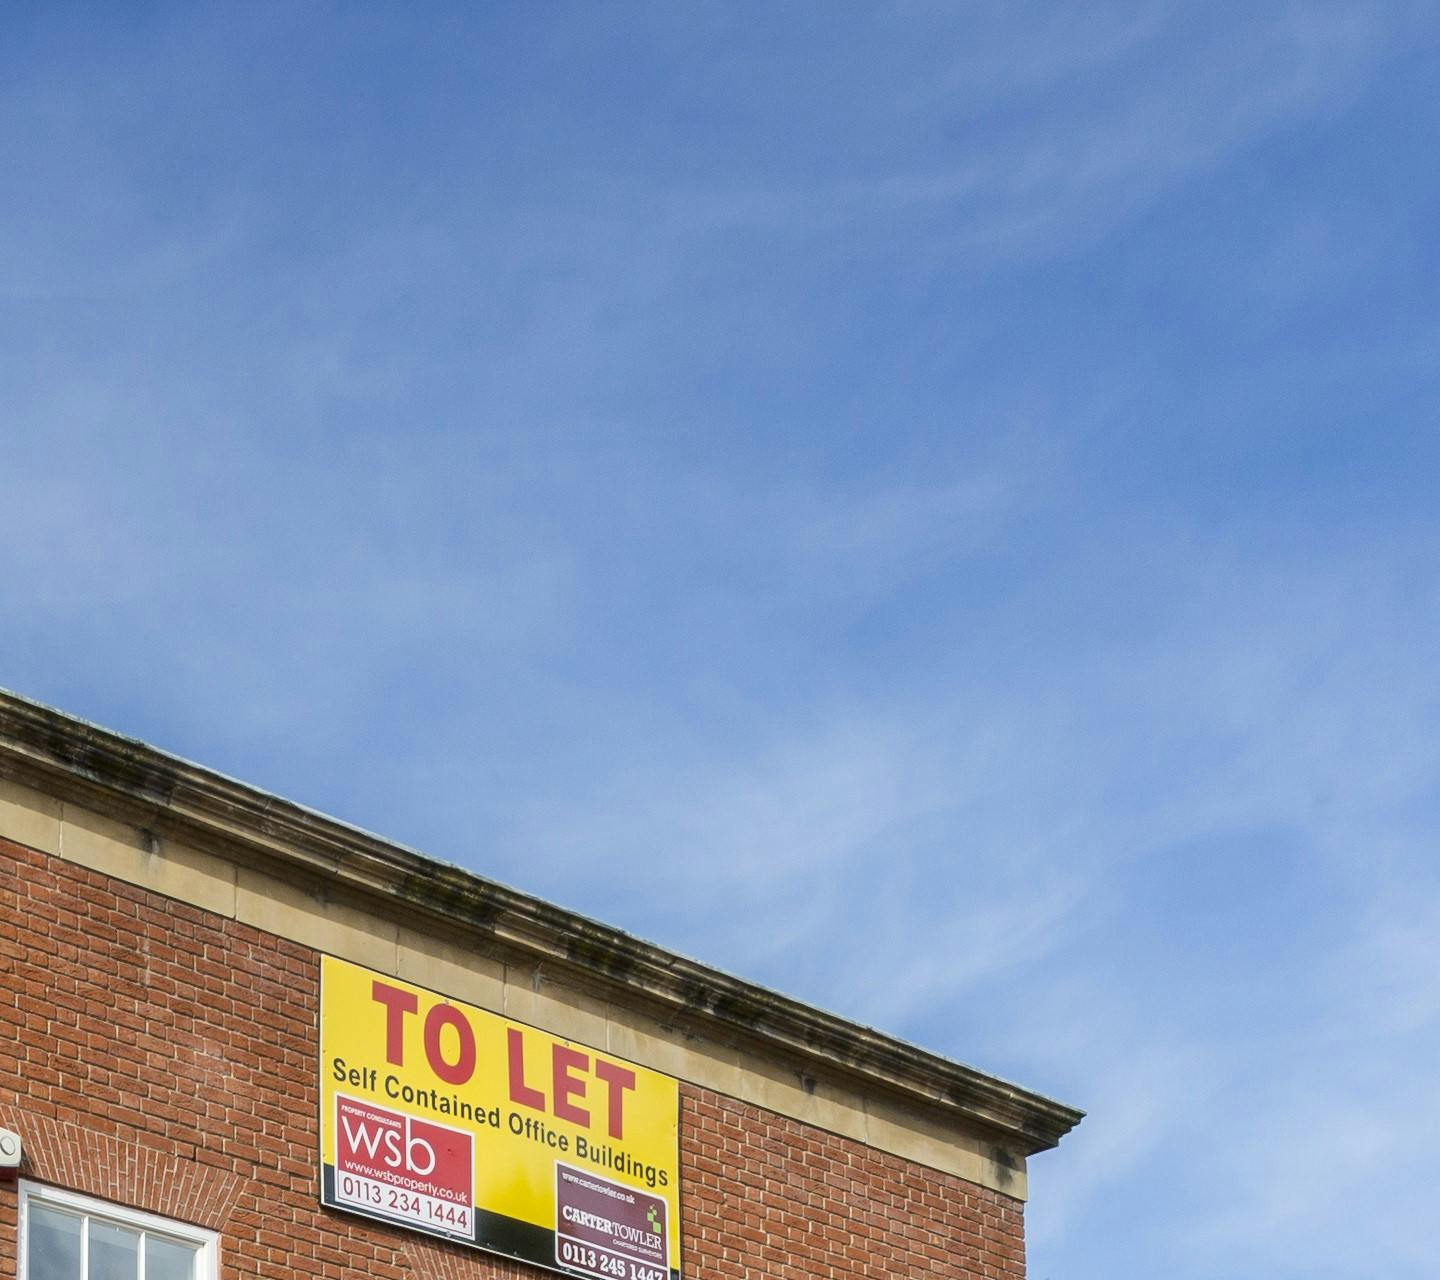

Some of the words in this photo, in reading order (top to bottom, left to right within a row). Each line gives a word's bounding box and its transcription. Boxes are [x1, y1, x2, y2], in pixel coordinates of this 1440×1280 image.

[371, 980, 477, 1085] TO
[506, 1027, 636, 1141] LET
[332, 1058, 377, 1092] Self
[385, 1073, 501, 1128] Contained
[509, 1112, 569, 1152] Office
[576, 1135, 669, 1188] Buildings
[341, 1104, 366, 1118] PROPERTY
[341, 1114, 436, 1176] wsb
[343, 1176, 382, 1204] 0113
[388, 1190, 421, 1216] 234
[427, 1201, 468, 1229] 1444
[344, 1160, 468, 1204] www.wsbproperty.co.uk
[562, 1204, 662, 1250] CARTERTOWLER
[562, 1242, 597, 1268] 0113
[600, 1254, 626, 1277] 245
